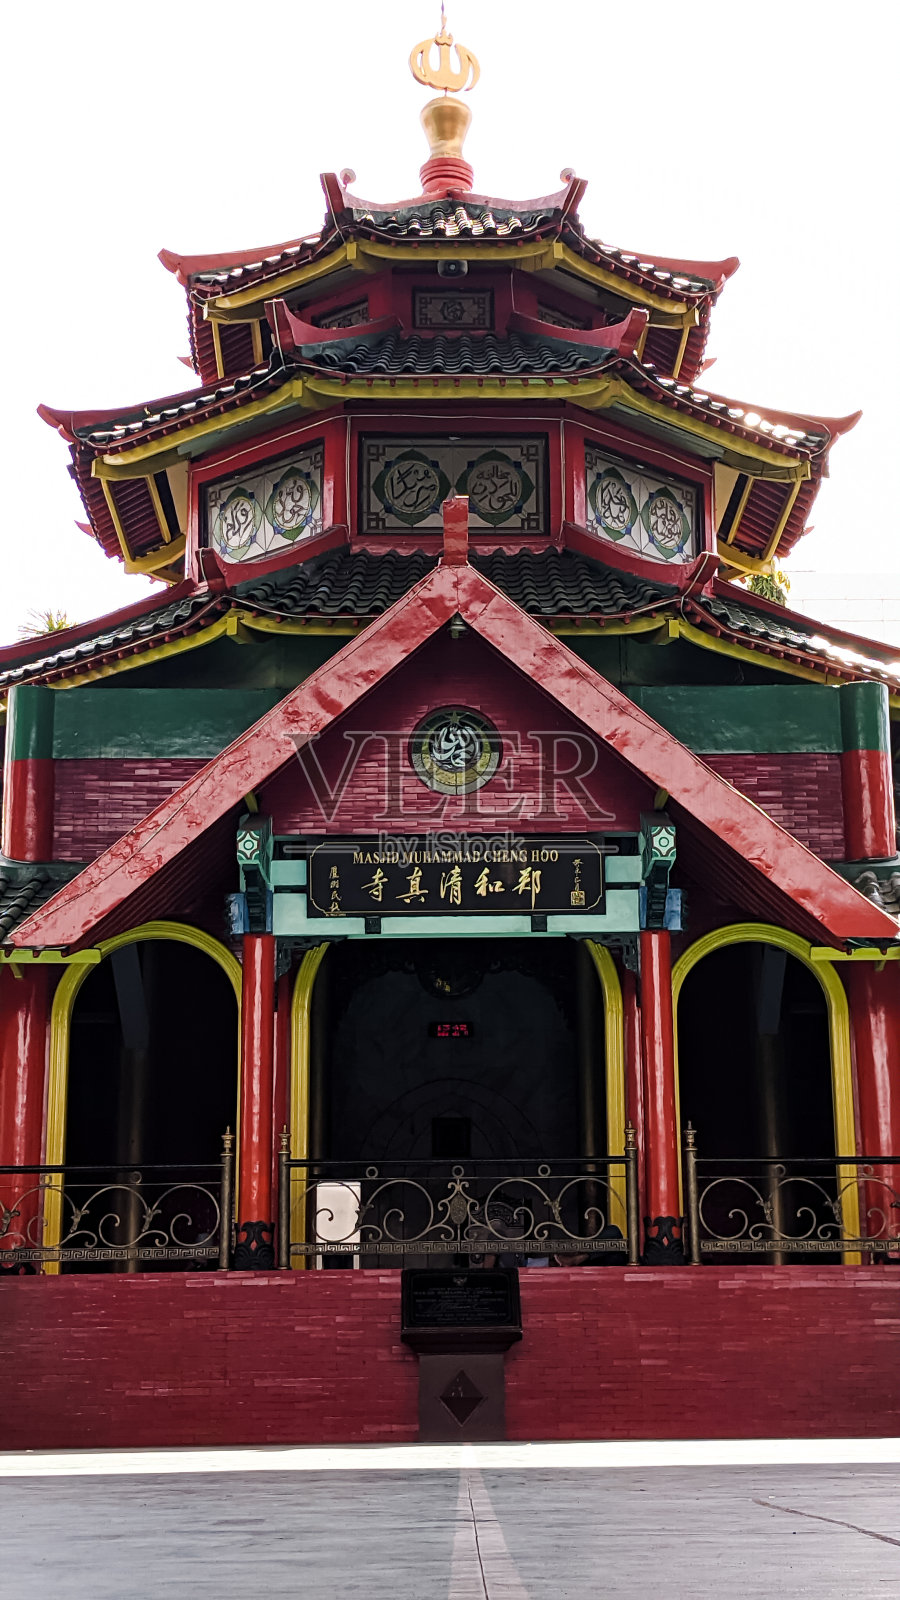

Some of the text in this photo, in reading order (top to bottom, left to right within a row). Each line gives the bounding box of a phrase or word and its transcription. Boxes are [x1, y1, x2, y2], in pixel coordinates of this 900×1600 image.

[353, 850, 559, 864] MASJID MUHAMMAD CHENG HOO
